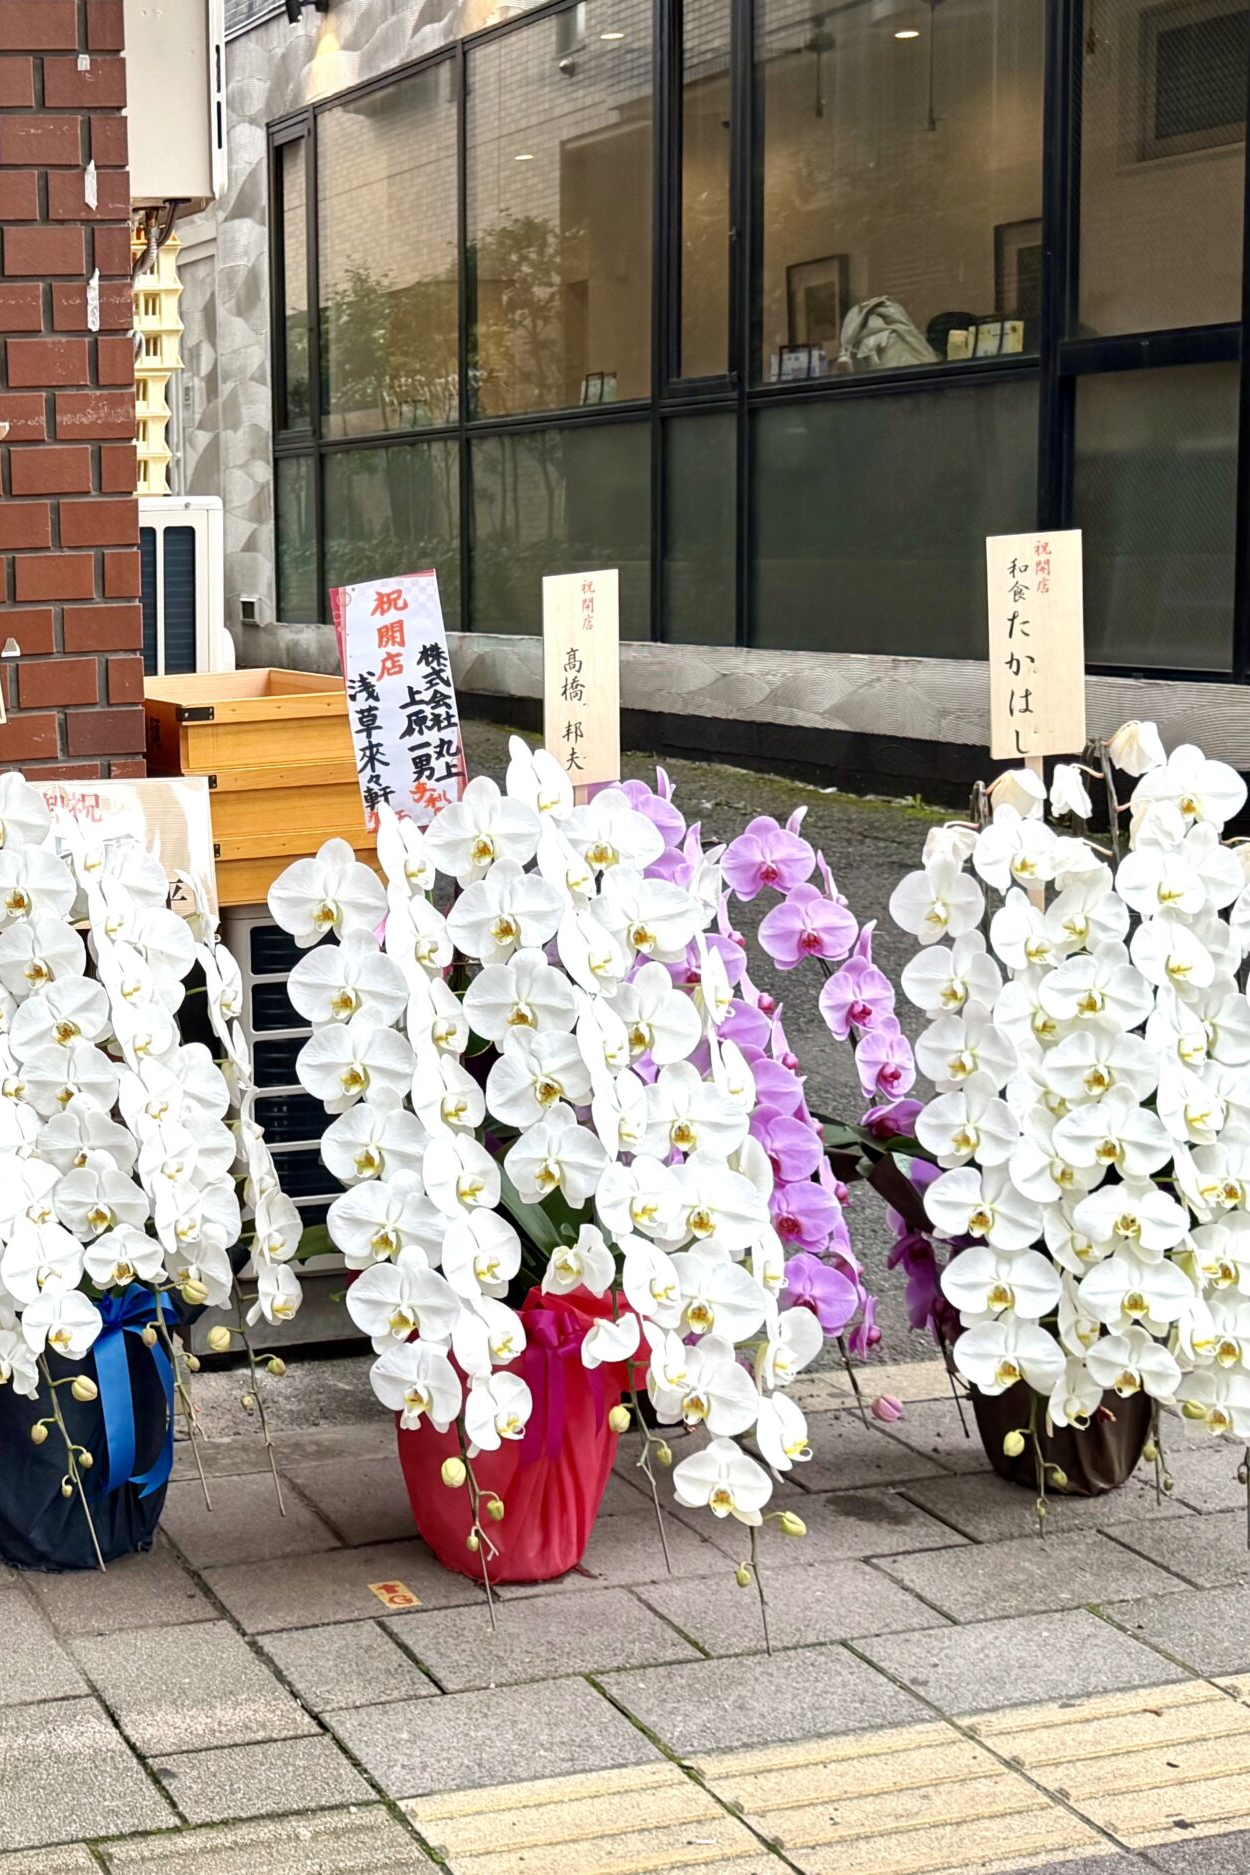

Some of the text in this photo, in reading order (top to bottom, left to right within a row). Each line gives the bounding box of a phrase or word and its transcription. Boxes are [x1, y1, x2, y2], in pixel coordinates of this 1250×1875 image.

[1033, 540, 1053, 594] 祝開店
[580, 579, 596, 631] 祝開店
[398, 685, 436, 783] 上原一男
[561, 720, 585, 772] 邦夫
